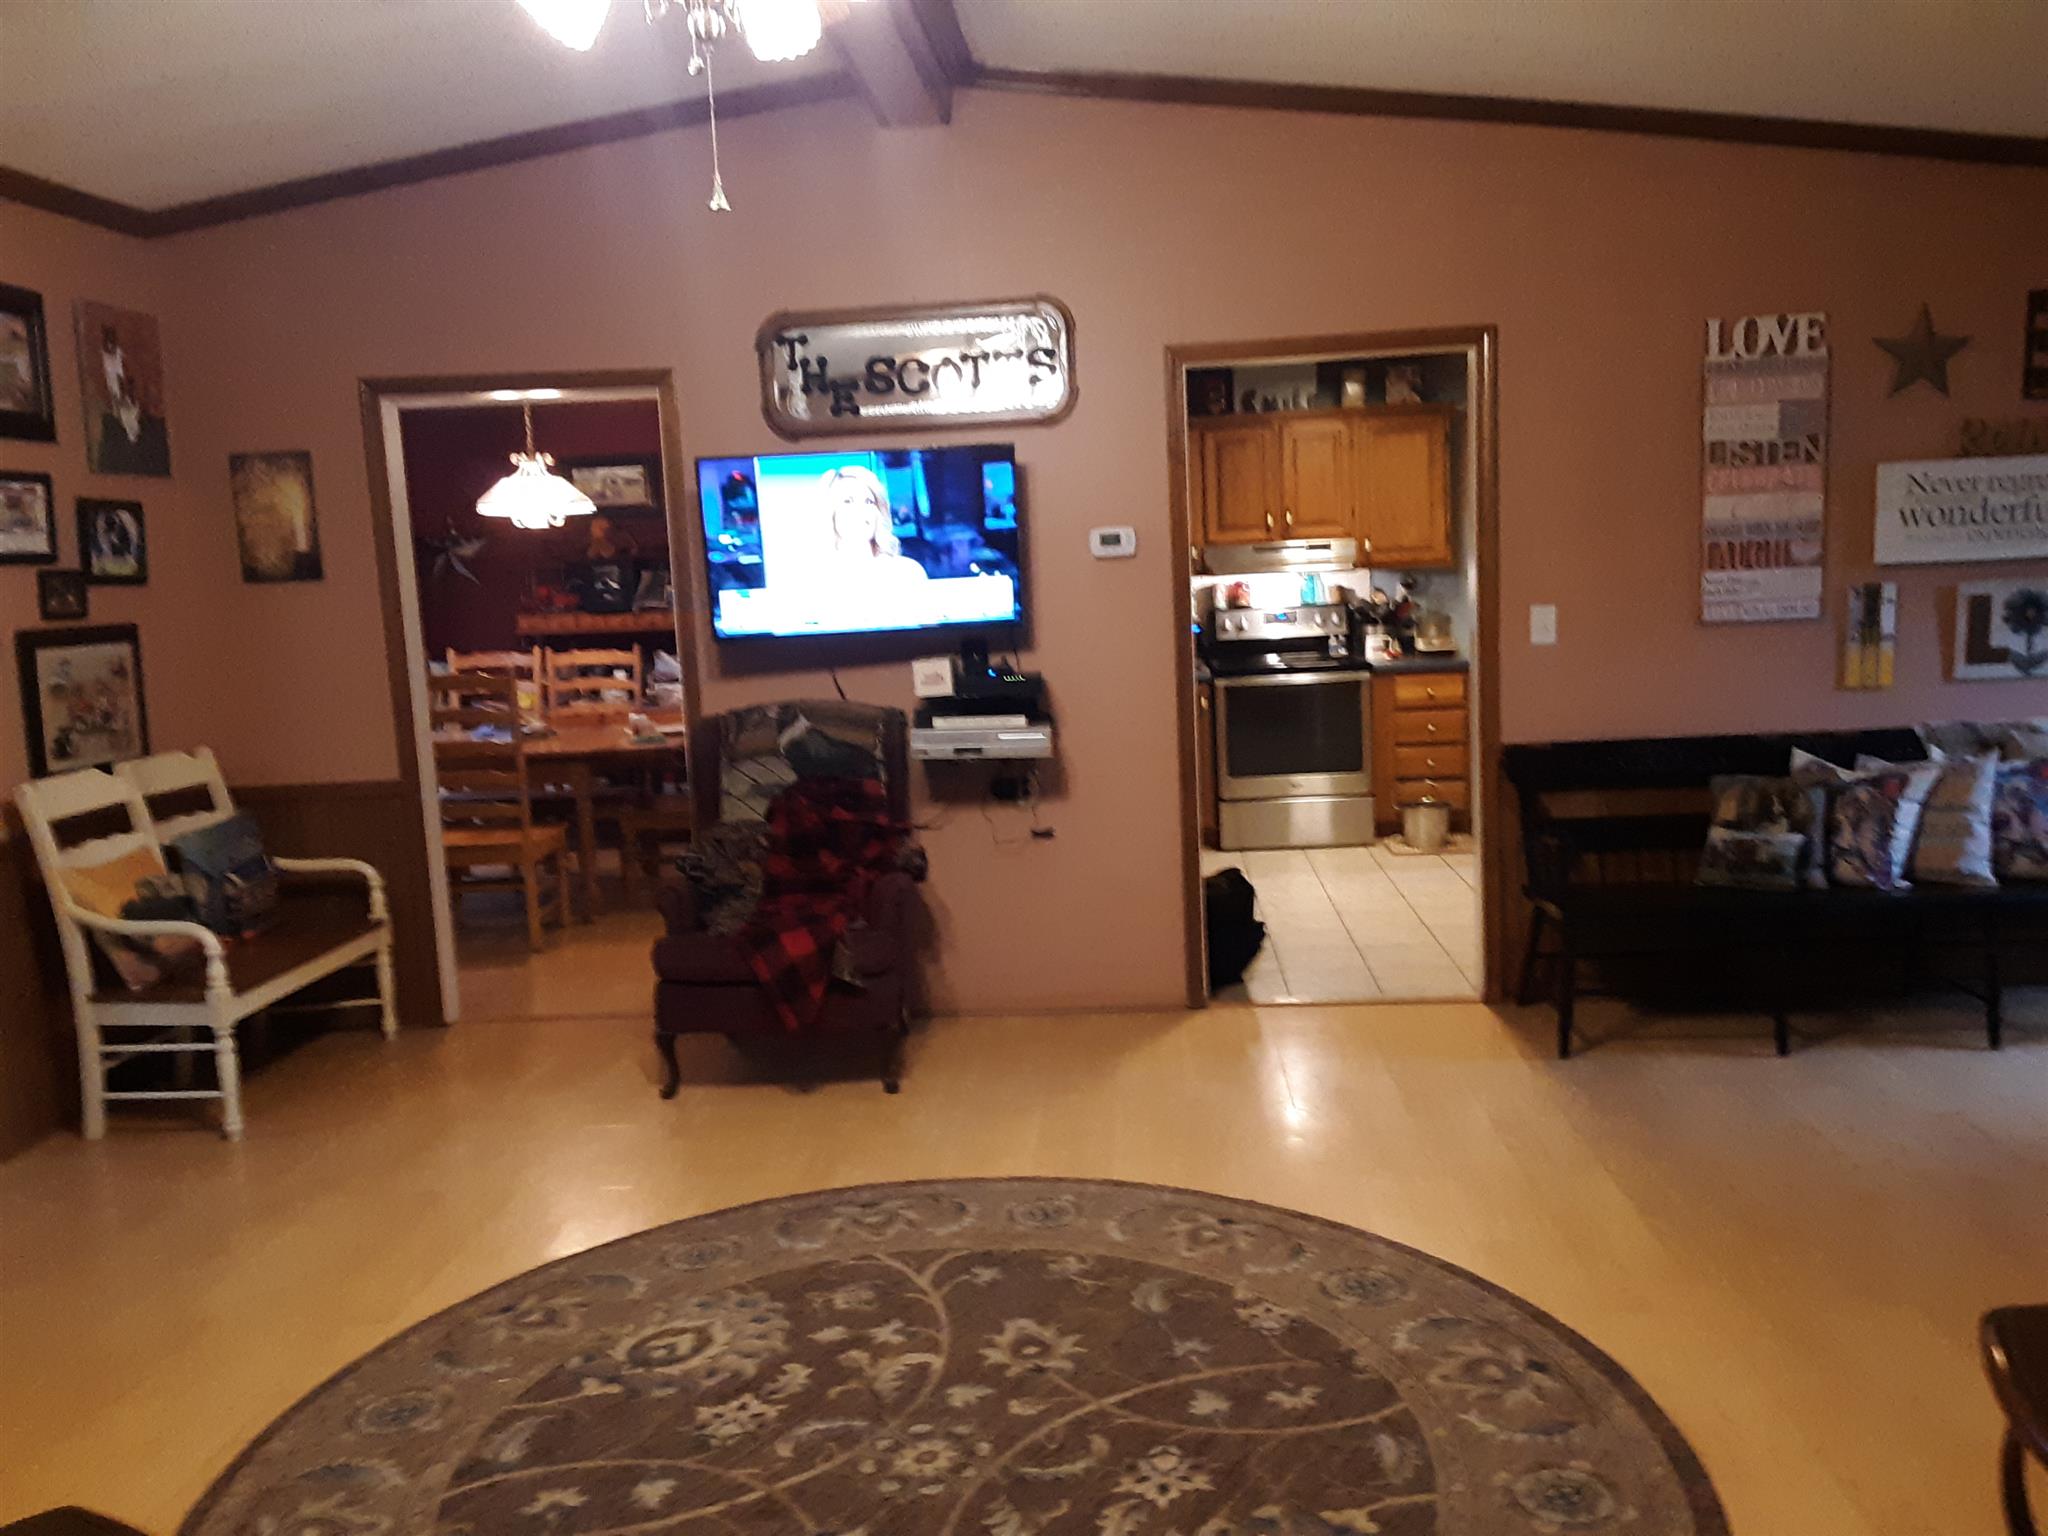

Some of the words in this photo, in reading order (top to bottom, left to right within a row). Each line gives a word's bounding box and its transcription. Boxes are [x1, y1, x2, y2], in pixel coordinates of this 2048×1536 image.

[1705, 313, 1828, 361] LOVE
[775, 333, 861, 417] THE
[1906, 472, 1978, 496] Never
